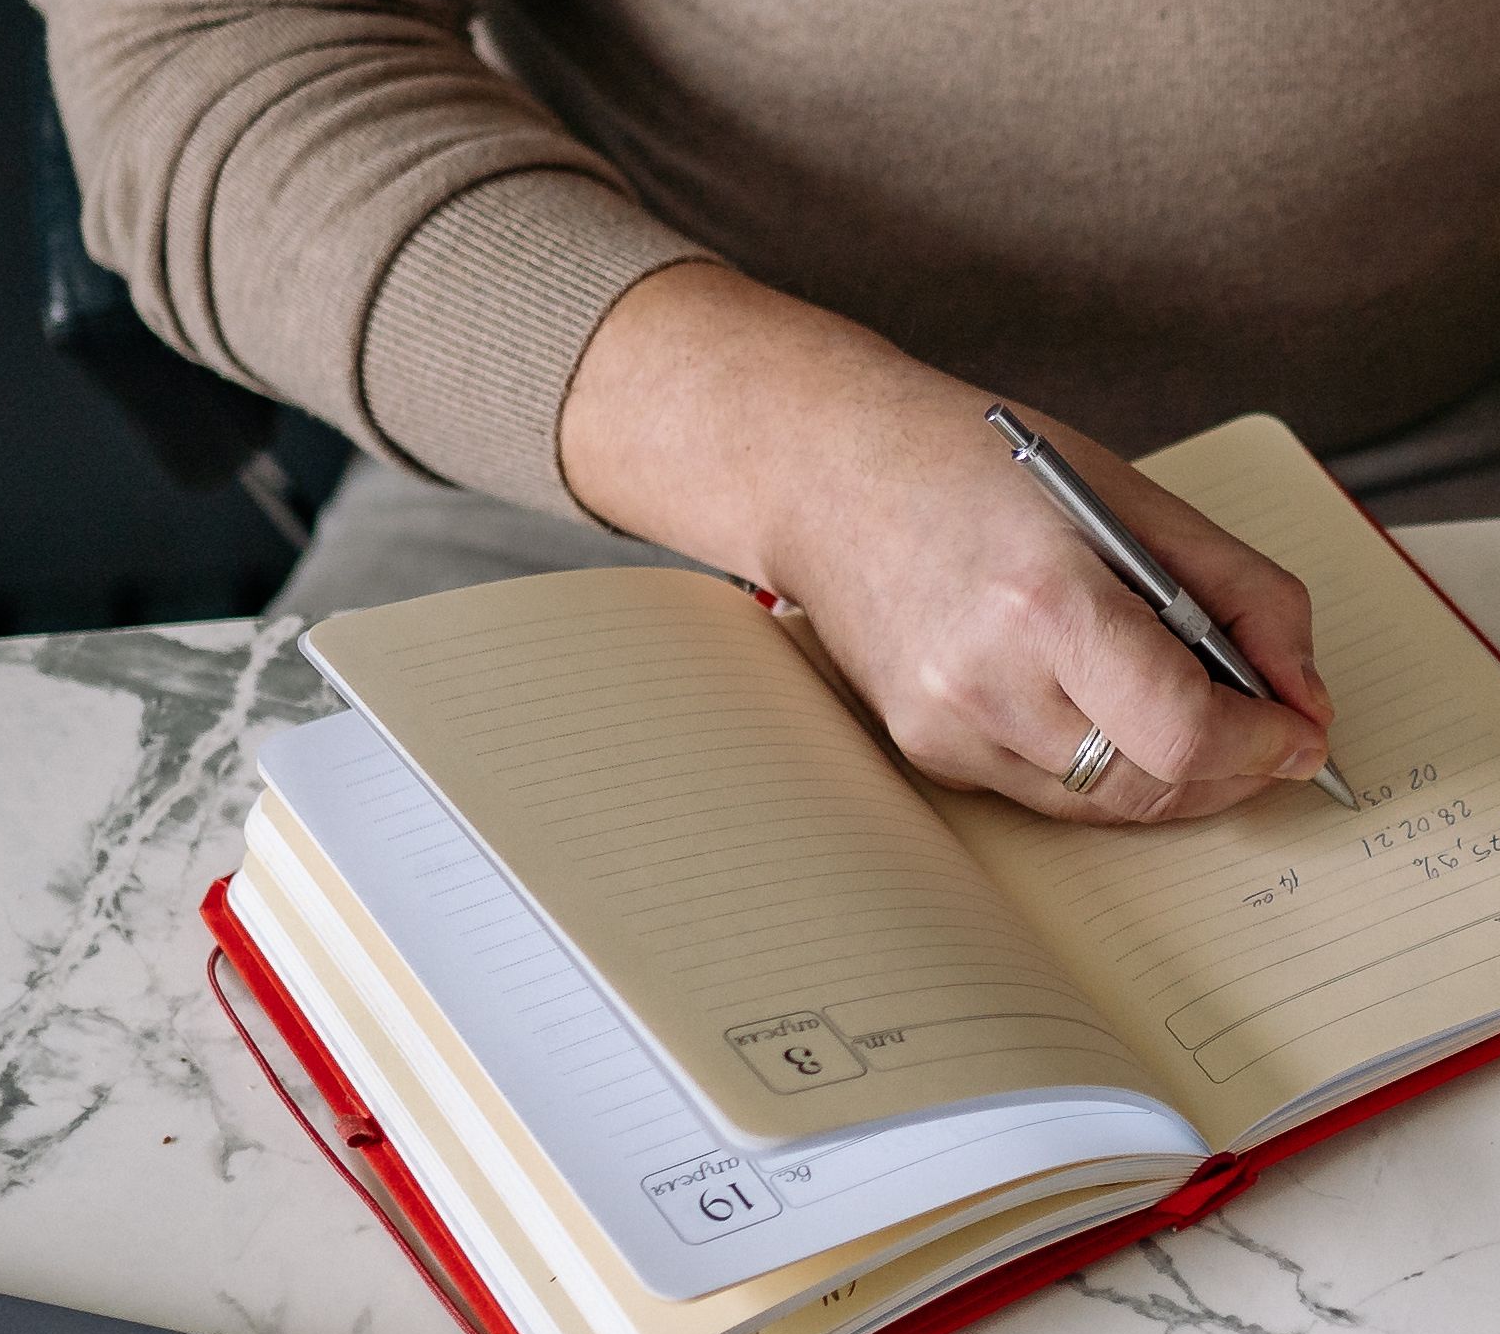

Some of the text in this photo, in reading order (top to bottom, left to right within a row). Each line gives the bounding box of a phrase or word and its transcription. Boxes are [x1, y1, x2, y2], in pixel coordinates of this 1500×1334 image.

[1360, 799, 1472, 859] 28.02.21
[733, 1017, 821, 1047] апреля
[783, 1045, 823, 1076] 3
[650, 1156, 741, 1197] апреля
[698, 1181, 756, 1223] 19
